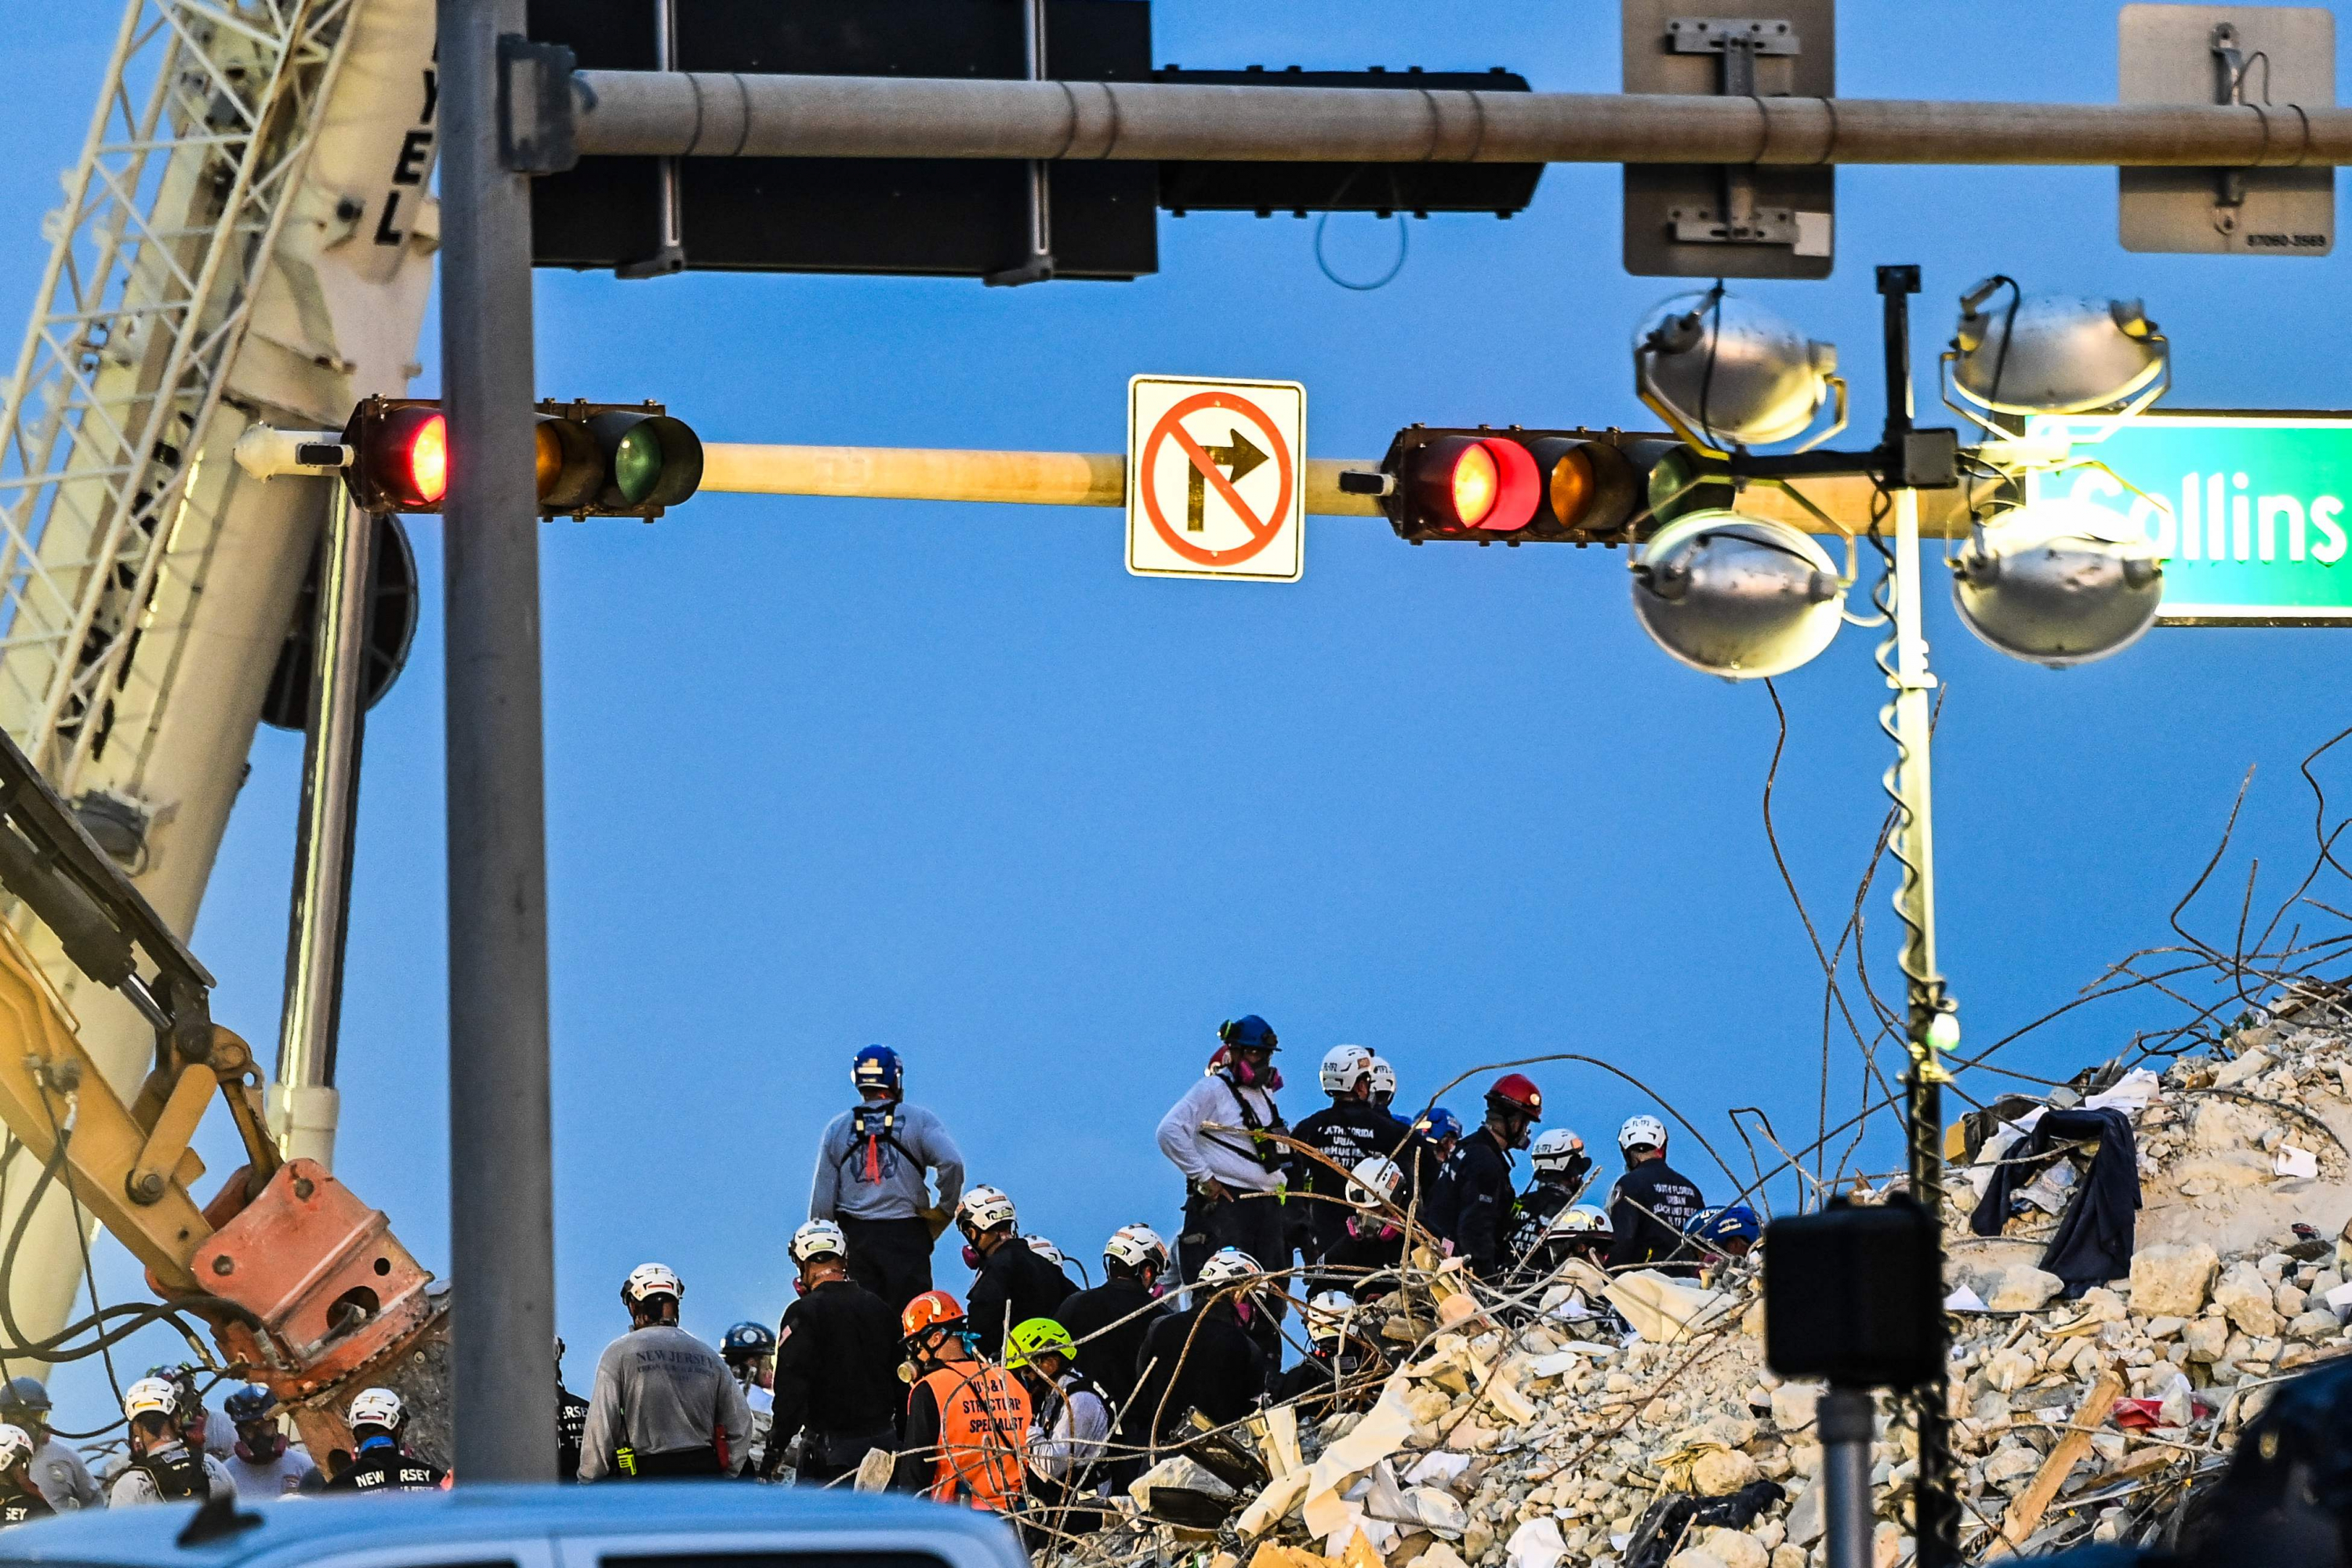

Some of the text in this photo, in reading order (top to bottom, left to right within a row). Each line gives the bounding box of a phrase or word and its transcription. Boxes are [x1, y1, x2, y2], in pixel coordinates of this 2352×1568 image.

[374, 41, 437, 245] YEL
[636, 1349, 713, 1368] NEW JERSEY
[962, 1397, 1022, 1414] STRCTURE
[969, 1417, 1024, 1434] SPEALST
[354, 1468, 430, 1488] NEW RSEY
